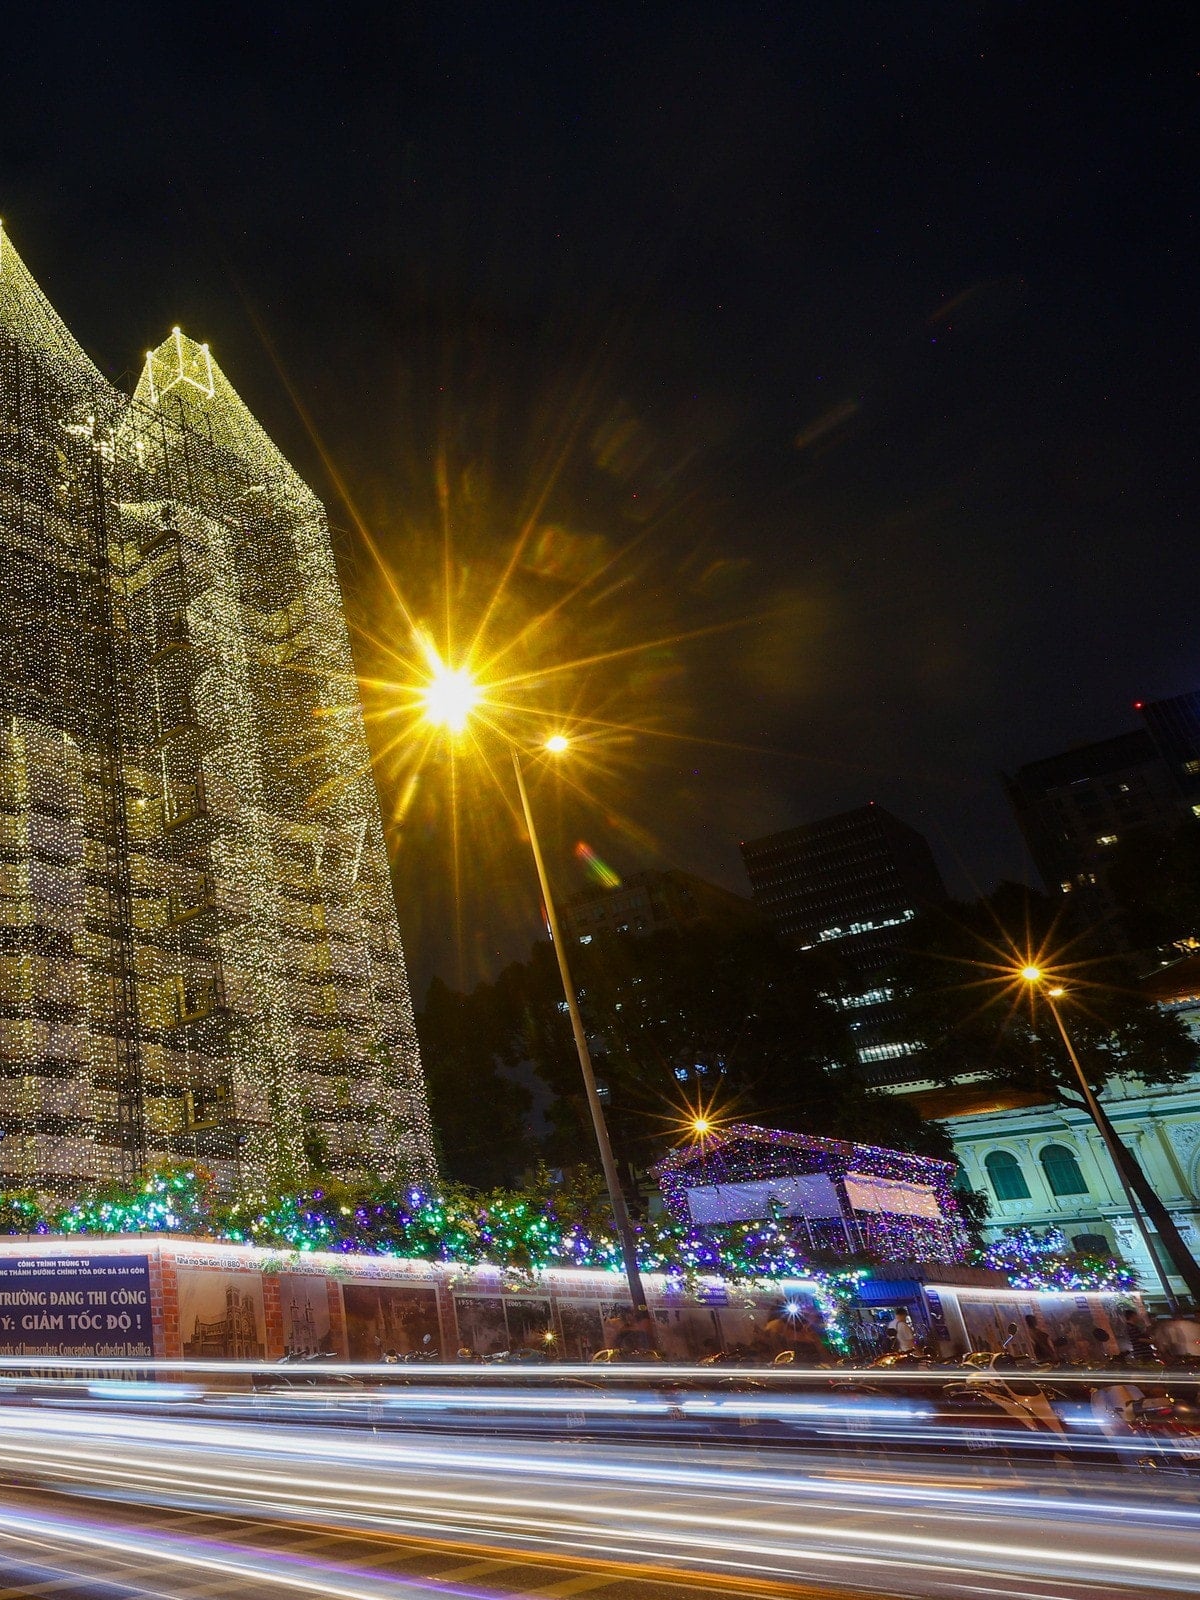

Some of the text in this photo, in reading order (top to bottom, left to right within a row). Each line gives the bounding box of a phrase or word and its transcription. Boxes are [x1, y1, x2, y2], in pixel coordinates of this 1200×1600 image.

[17, 1260, 35, 1268] CÔNG
[49, 1291, 84, 1306] ĐANG
[87, 1291, 107, 1305] THI
[110, 1288, 147, 1305] CÔNG
[1, 1314, 15, 1330] Ý:
[21, 1310, 64, 1330] GIẢM
[68, 1310, 103, 1330] TỐC
[106, 1311, 131, 1333] ĐỘ
[15, 1342, 22, 1355] of
[23, 1342, 58, 1356] Immaculate
[59, 1342, 94, 1357] Conception
[96, 1342, 126, 1356] Cathedral
[127, 1342, 151, 1356] Basilica
